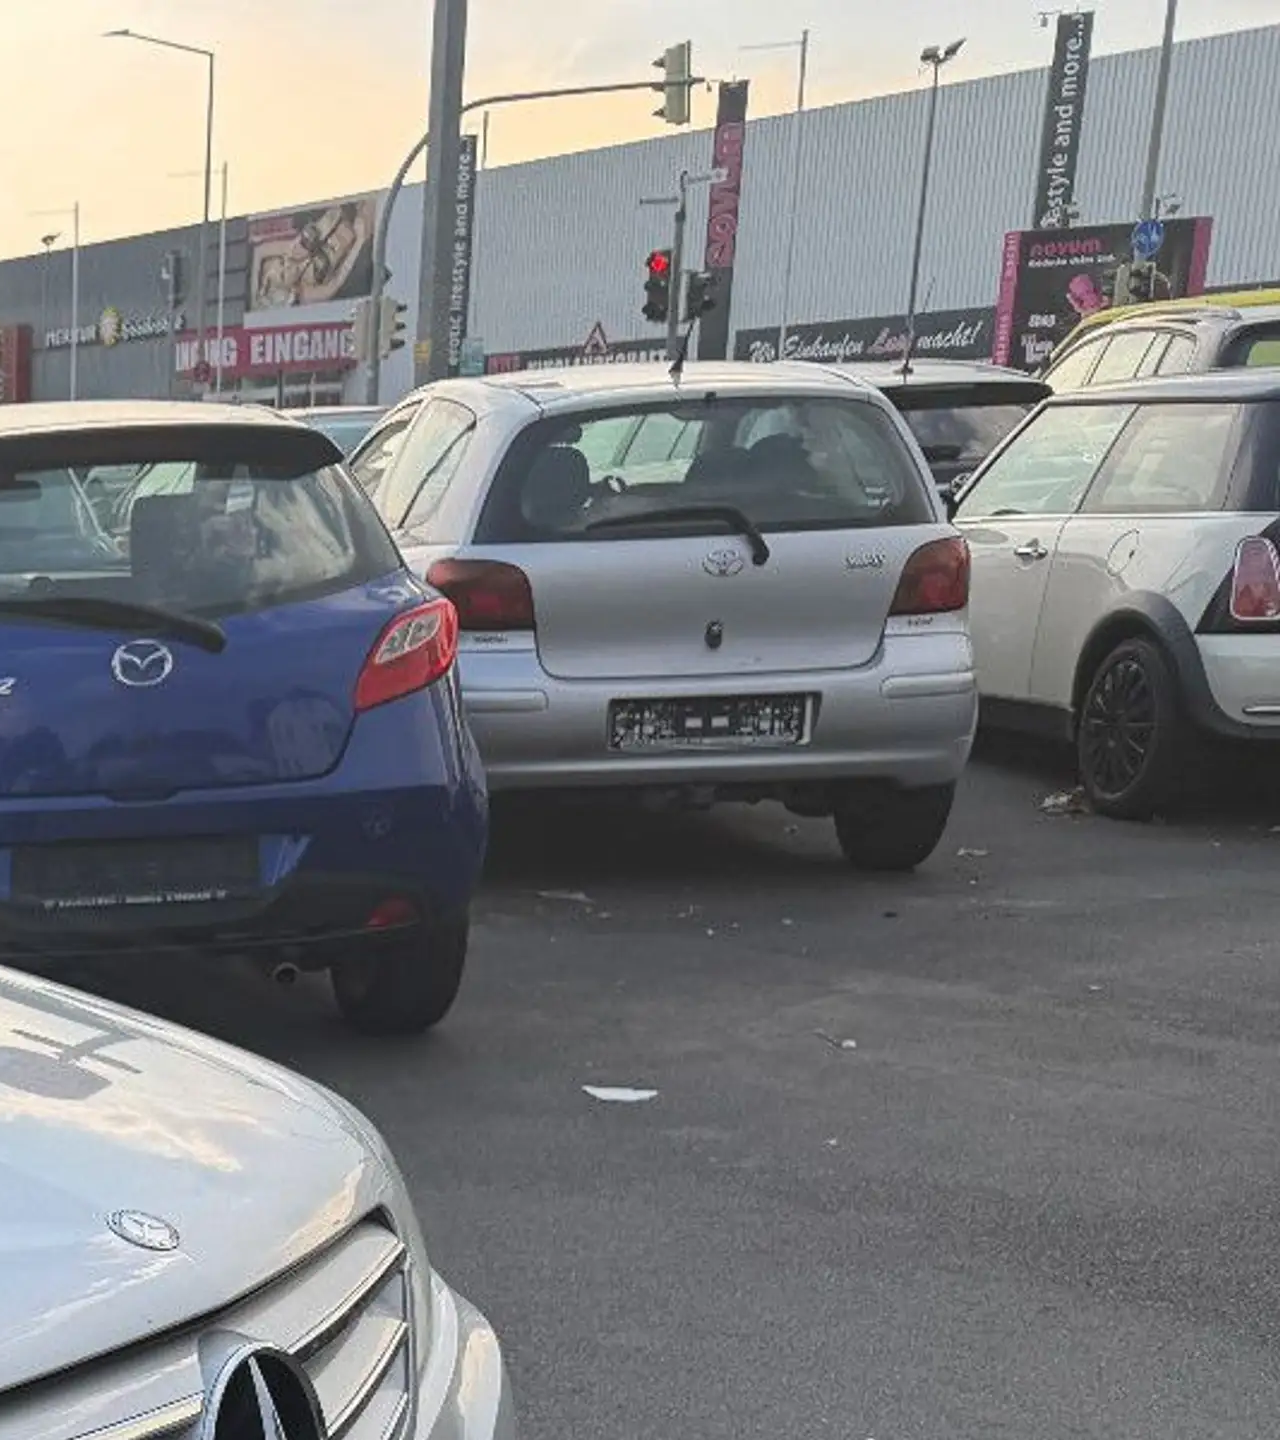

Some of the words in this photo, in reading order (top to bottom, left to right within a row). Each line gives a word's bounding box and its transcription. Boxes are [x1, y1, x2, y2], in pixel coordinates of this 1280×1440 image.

[1055, 104, 1073, 146] and
[454, 204, 468, 237] and
[251, 329, 356, 365] EINGANG
[917, 320, 983, 348] macht!
